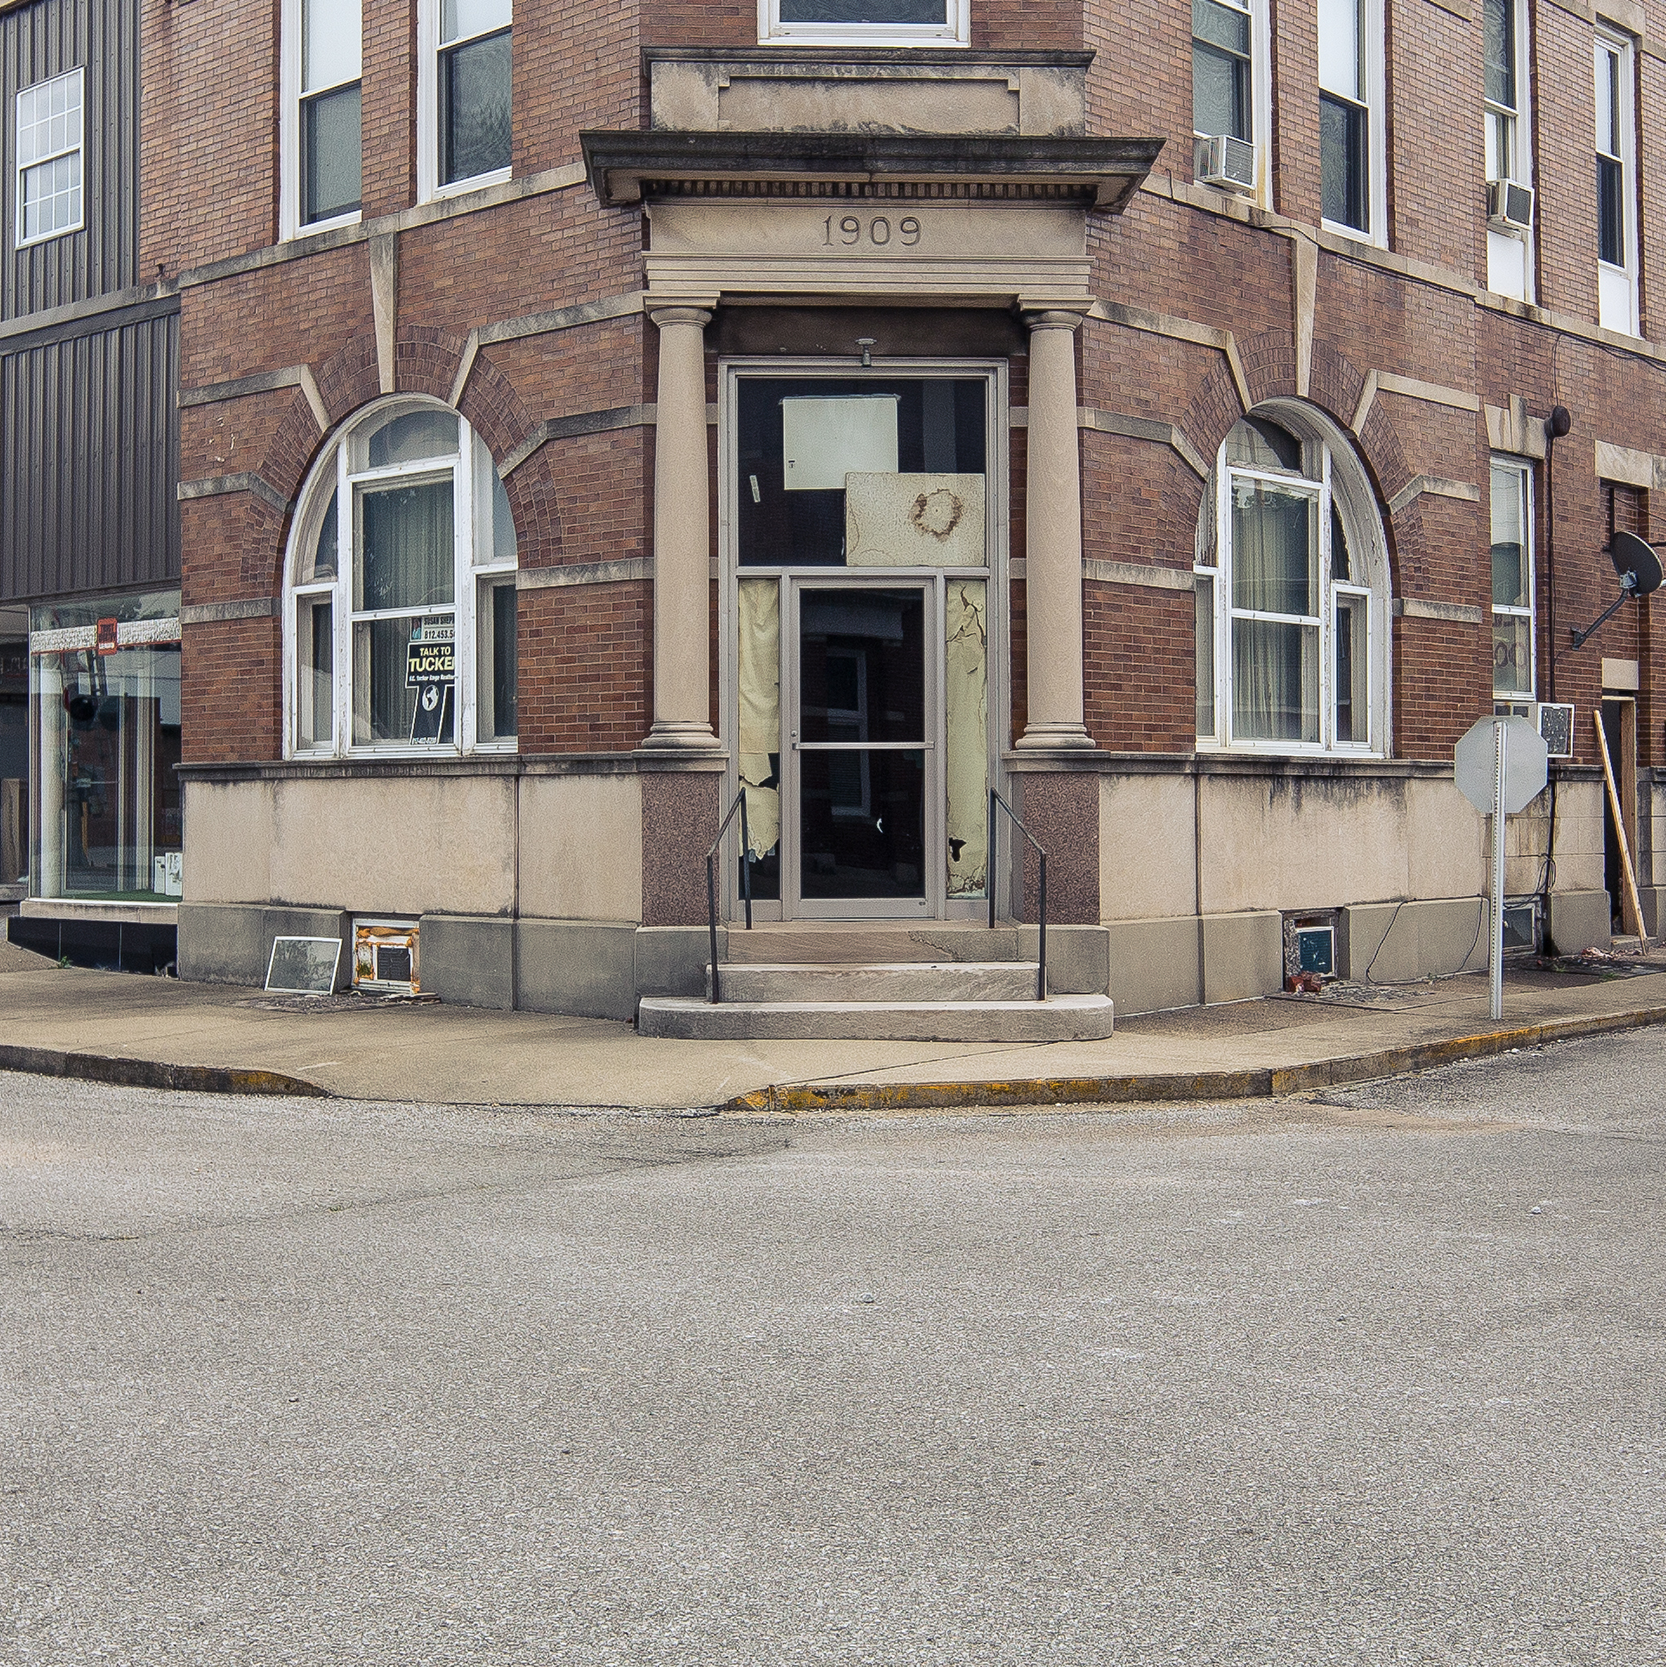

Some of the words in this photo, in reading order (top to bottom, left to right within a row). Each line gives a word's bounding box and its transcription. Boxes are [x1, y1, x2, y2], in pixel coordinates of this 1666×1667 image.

[821, 215, 922, 246] 1909
[424, 629, 455, 640] 812.453.5
[419, 647, 439, 657] TALK
[440, 646, 451, 655] TO
[409, 656, 455, 673] TUCKE
